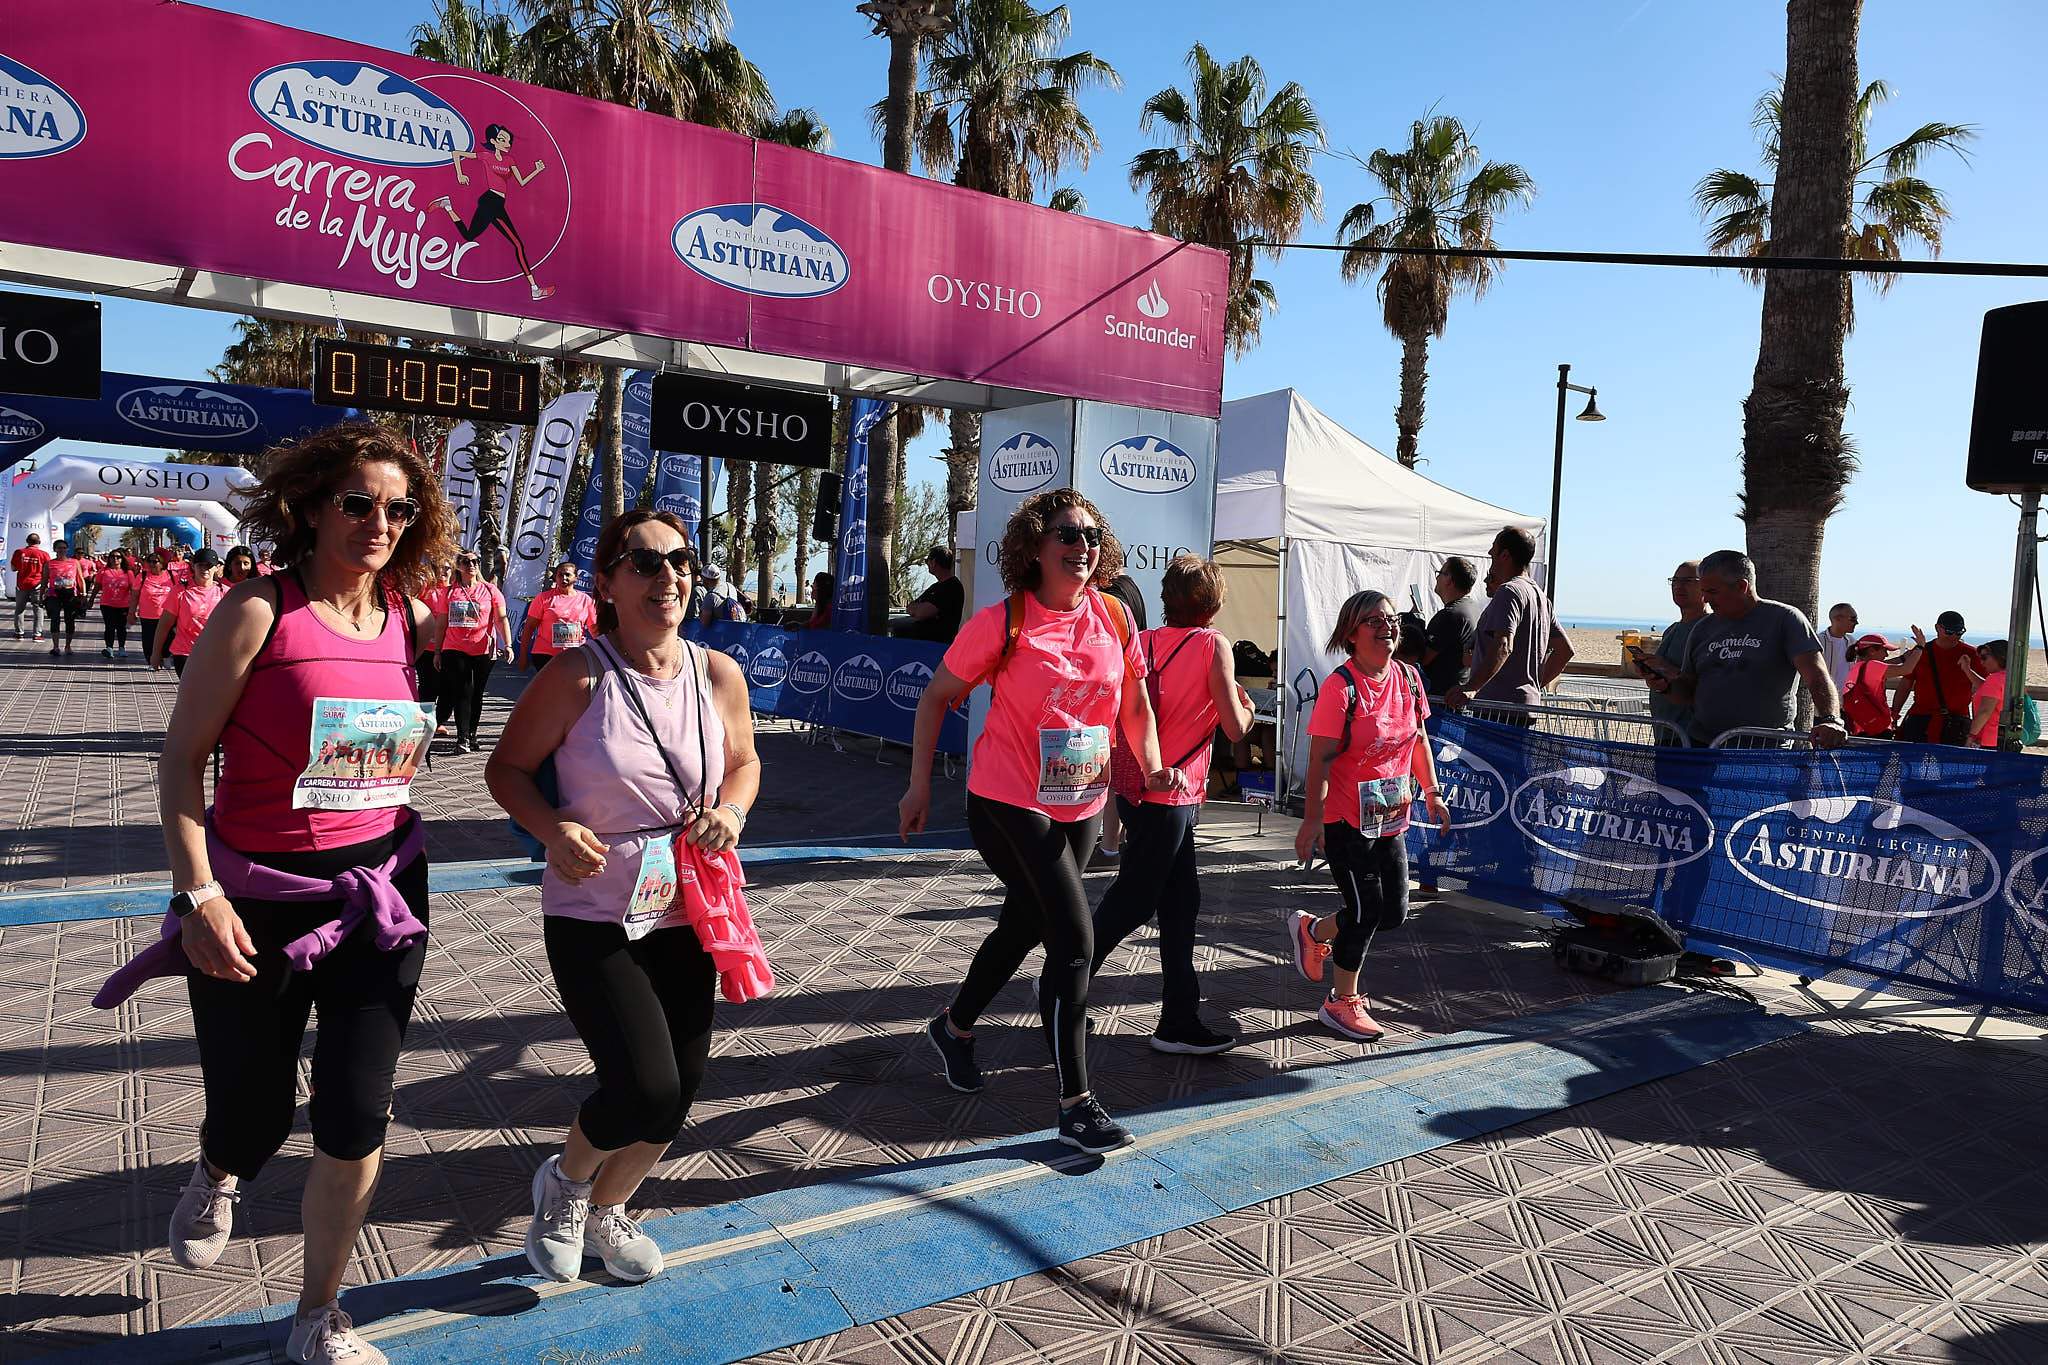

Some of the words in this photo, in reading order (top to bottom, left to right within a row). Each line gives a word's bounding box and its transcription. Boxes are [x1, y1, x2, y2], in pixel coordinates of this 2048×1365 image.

[268, 80, 456, 153] ASTURIANA
[305, 84, 377, 108] CENTRAL
[383, 102, 451, 125] LECHERA
[228, 132, 417, 213] Carrera
[275, 194, 312, 229] de
[319, 199, 345, 237] la
[337, 204, 480, 289] Mujer
[686, 225, 837, 283] ASTURIANA
[715, 227, 771, 246] CENTRAL
[777, 239, 832, 258] LECHERA
[928, 274, 1041, 319] OYSHO
[1104, 314, 1197, 350] Santander
[127, 397, 249, 429] ASTURIANA
[682, 402, 808, 442] OYSHO
[98, 465, 210, 491] OYSHO
[993, 457, 1054, 479] ASTURIANA
[1107, 453, 1189, 483] ASTURIANA
[27, 482, 64, 492] OYSHO
[516, 418, 575, 560] OYSHO
[836, 670, 879, 691] ASTURIANA
[303, 779, 337, 788] CARRERA
[338, 779, 349, 788] DE
[1439, 767, 1492, 786] LECHERA
[307, 792, 351, 802] OYSHO
[1557, 790, 1617, 809] CENTRAL
[1624, 802, 1692, 821] LECHERA
[1520, 788, 1695, 853] ASTURIANA
[1786, 826, 1867, 847] CENTRAL
[1877, 838, 1970, 860] LECHERA
[1740, 824, 1973, 899] ASTURIANA
